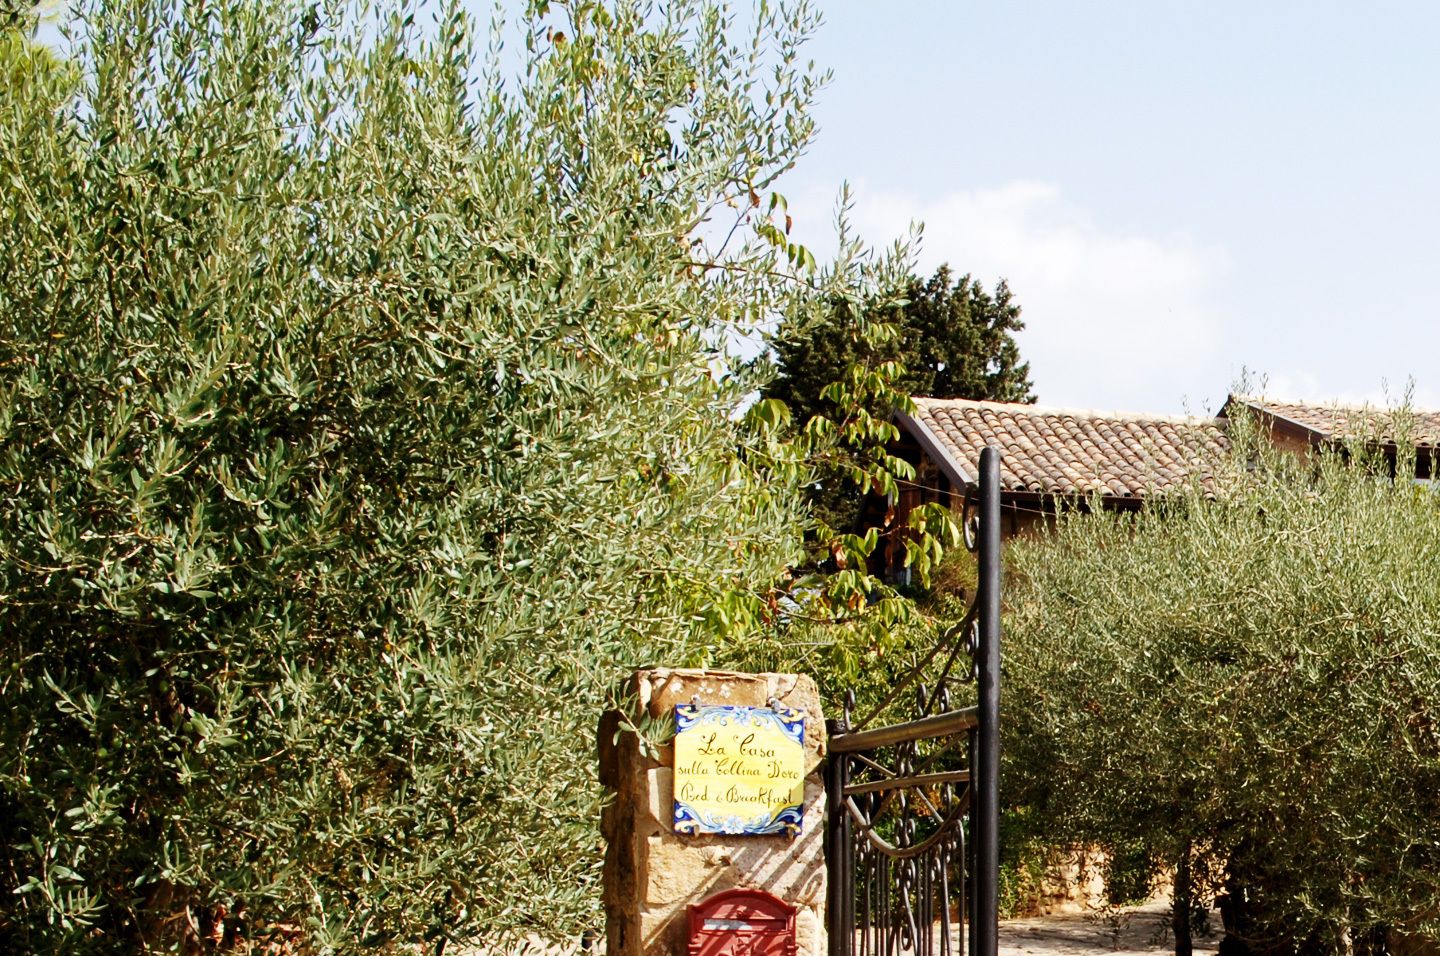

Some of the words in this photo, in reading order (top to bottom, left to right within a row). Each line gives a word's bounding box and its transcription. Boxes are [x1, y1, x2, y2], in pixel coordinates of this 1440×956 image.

[698, 732, 726, 756] La
[734, 733, 775, 757] Casa
[678, 760, 709, 775] sulla
[715, 758, 761, 776] Collina
[680, 780, 708, 802] Bed
